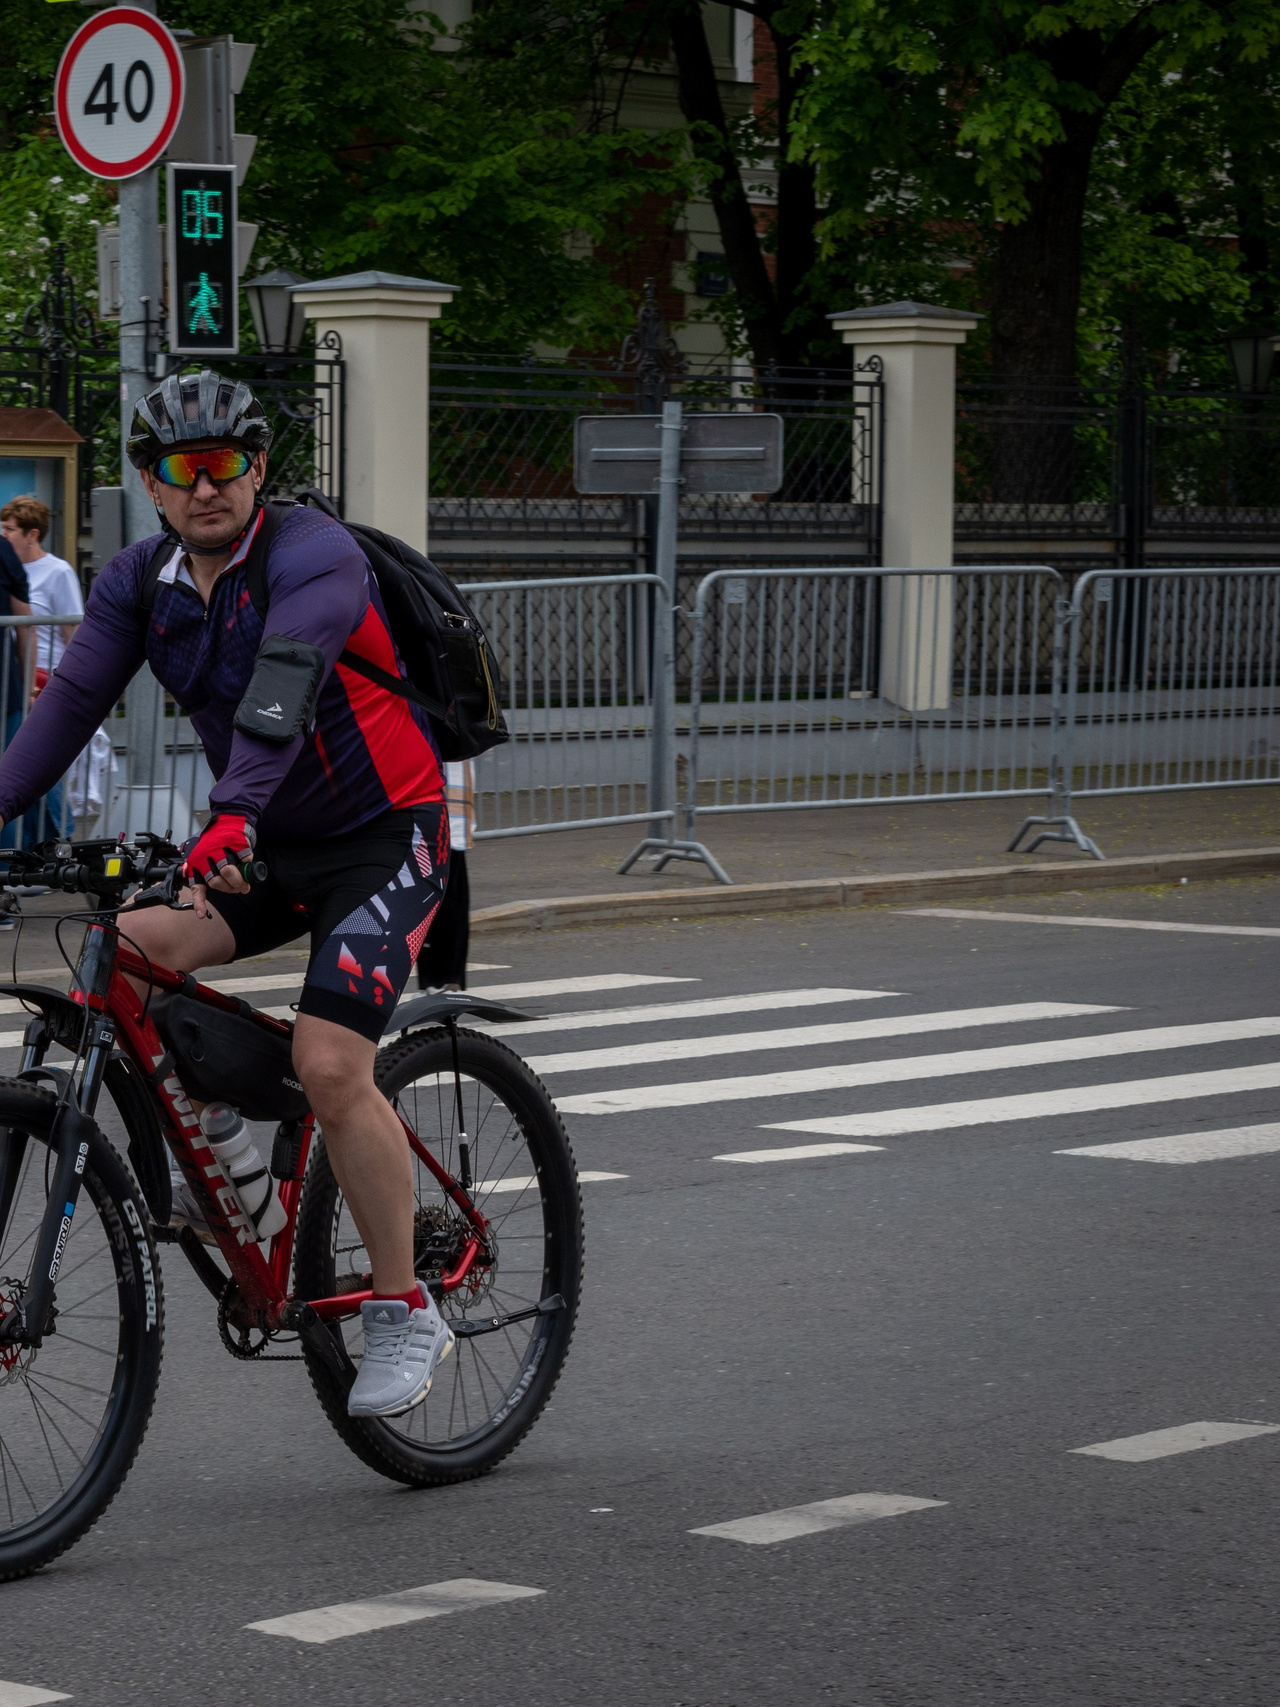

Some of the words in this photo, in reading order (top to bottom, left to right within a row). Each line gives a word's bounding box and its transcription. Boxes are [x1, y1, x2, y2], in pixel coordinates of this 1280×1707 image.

[83, 60, 155, 126] 40
[182, 189, 223, 239] 05
[256, 708, 284, 720] DEMIX
[151, 1042, 257, 1247] TWITTER
[122, 1198, 145, 1238] CST
[136, 1240, 157, 1333] PATROL
